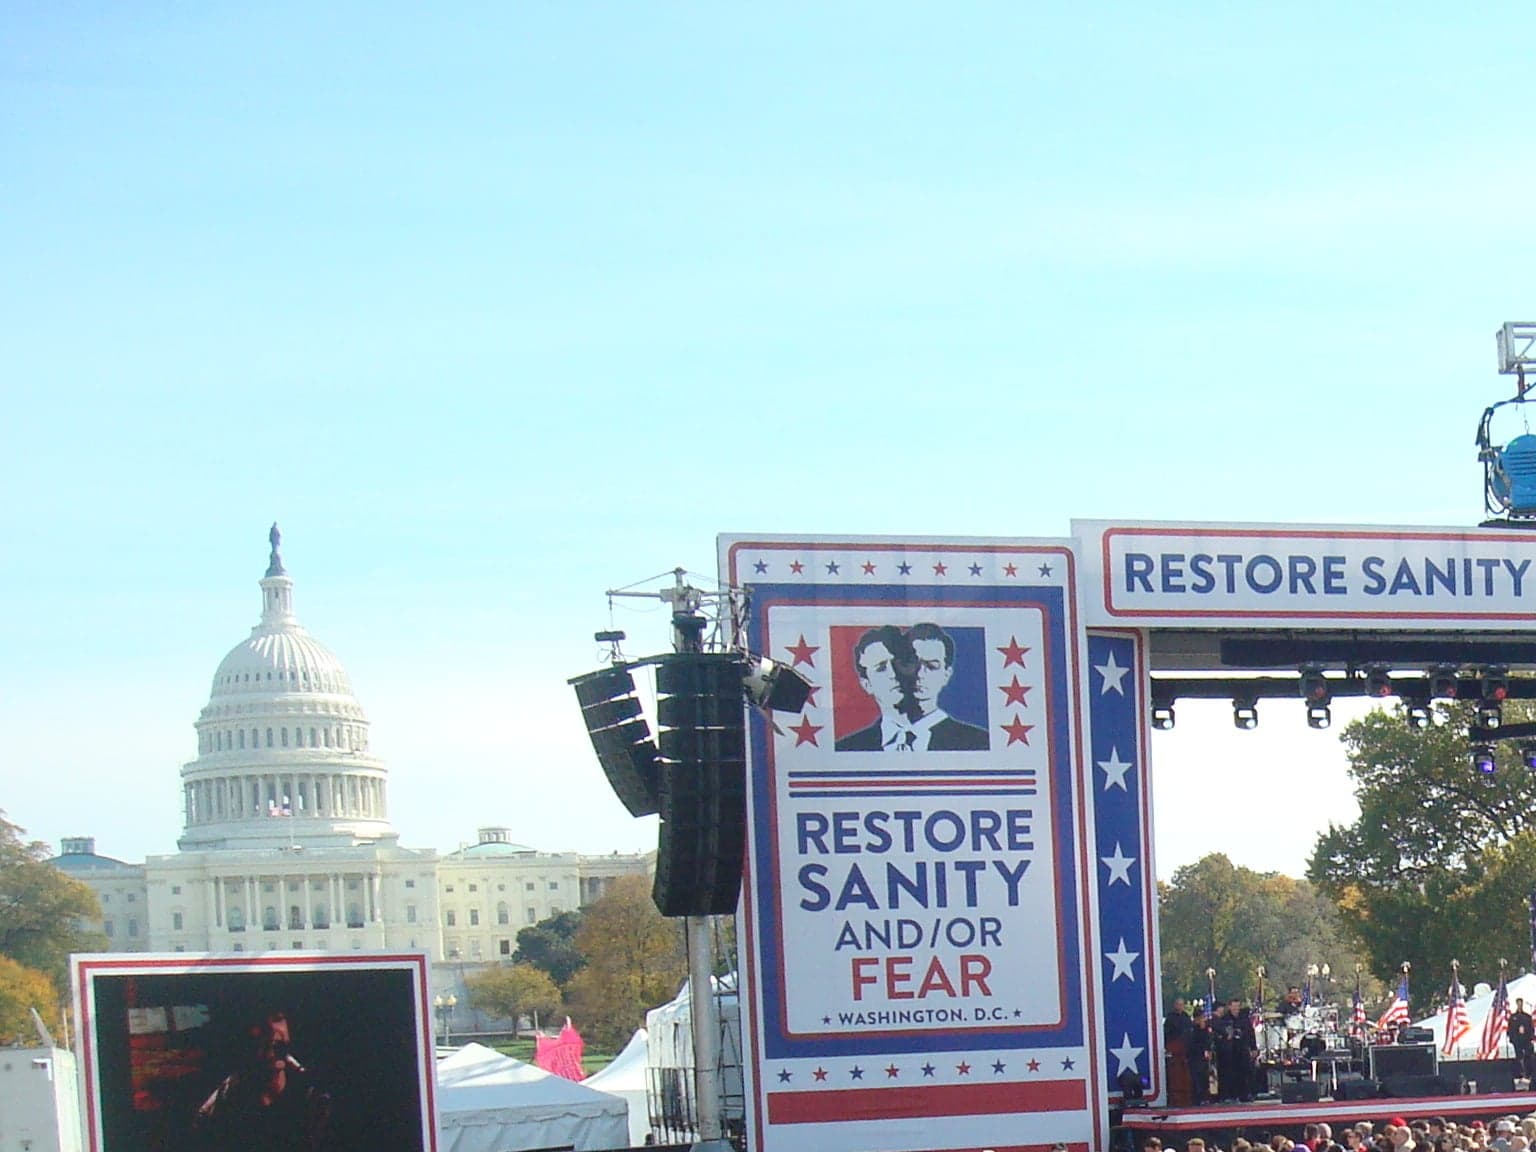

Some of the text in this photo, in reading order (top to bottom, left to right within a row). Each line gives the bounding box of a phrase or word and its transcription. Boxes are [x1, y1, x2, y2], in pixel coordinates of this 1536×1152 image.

[1124, 552, 1349, 596] RESTORE
[1362, 556, 1532, 598] SANITY
[796, 809, 1034, 855] RESTORE
[798, 859, 1032, 912] SANITY
[834, 917, 1003, 951] AND/OR
[852, 954, 993, 1001] FEAR
[974, 1007, 1008, 1022] D.C.
